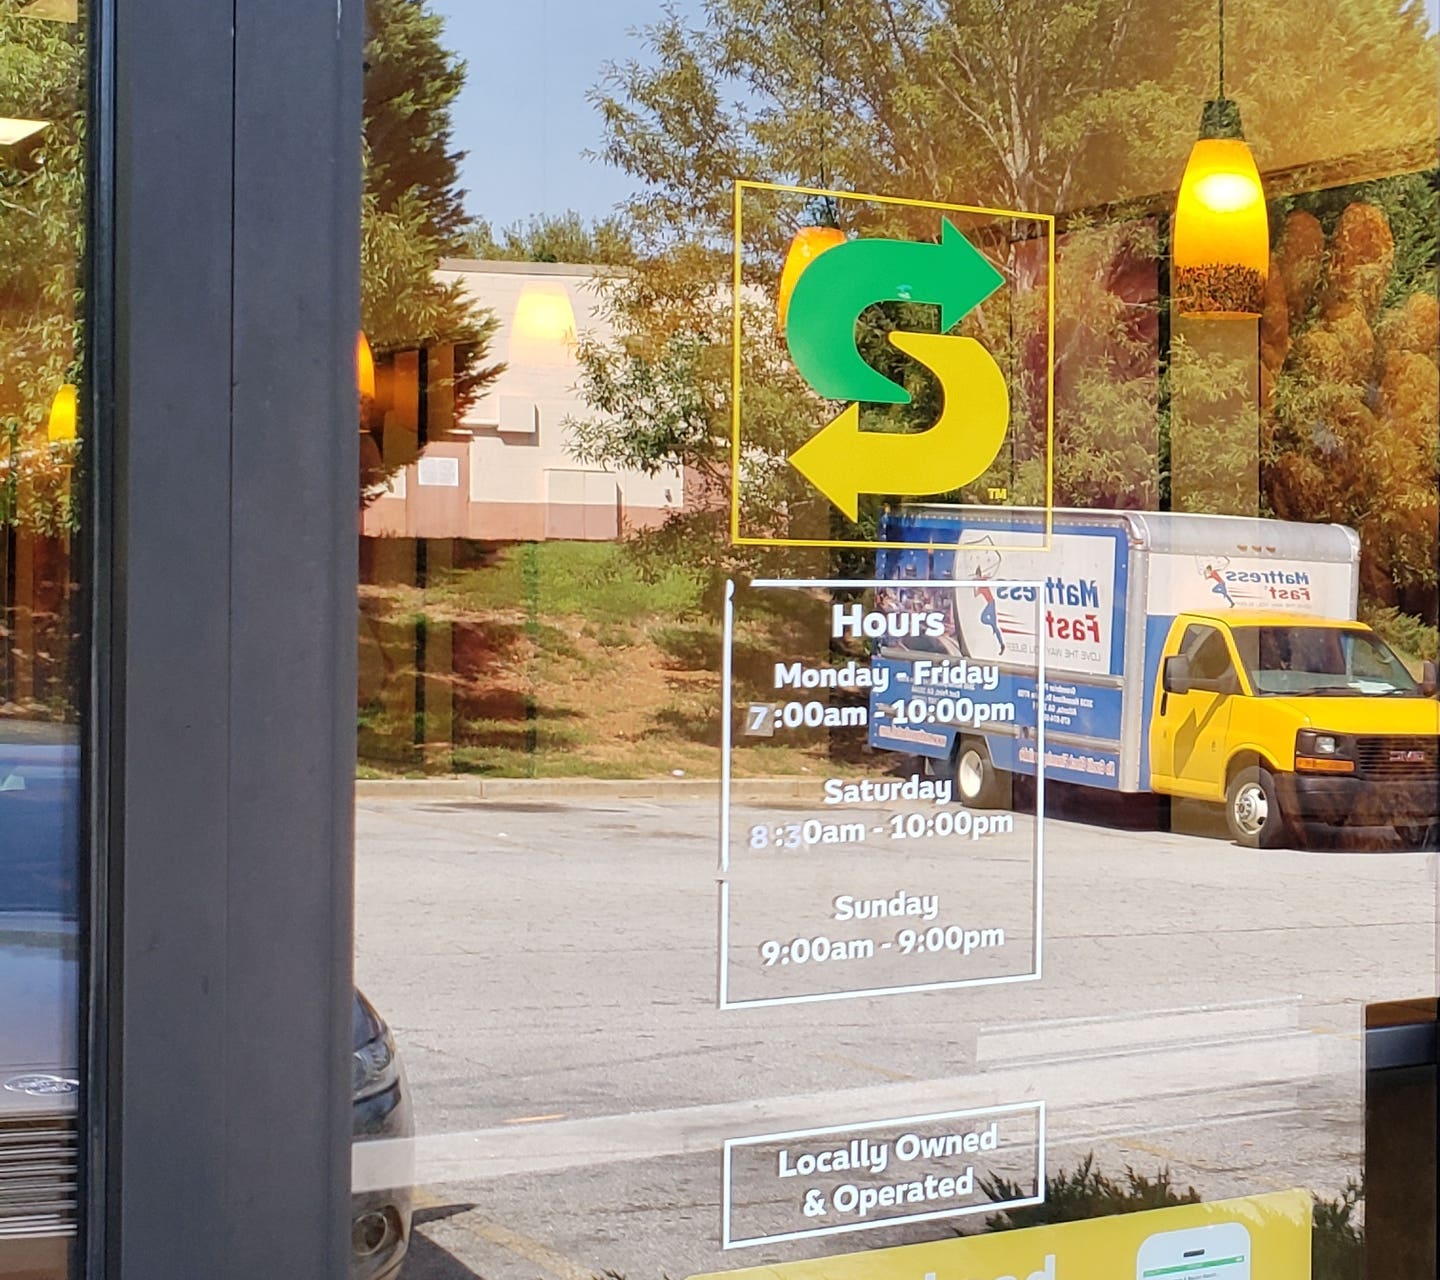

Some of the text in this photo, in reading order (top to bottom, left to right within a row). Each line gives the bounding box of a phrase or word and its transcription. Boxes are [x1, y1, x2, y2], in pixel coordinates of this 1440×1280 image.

[832, 604, 945, 638] Hours
[774, 661, 890, 693] Monday
[914, 659, 999, 691] Friday
[892, 697, 1015, 728] 10:00pm
[824, 775, 953, 806] Saturday
[890, 811, 1014, 840] 10:00pm
[834, 890, 939, 920] Sunday
[761, 936, 874, 967] 9:00am
[898, 926, 1005, 956] 9:00pm
[778, 1122, 998, 1178] Locally Owned
[803, 1167, 974, 1217] & Operated
